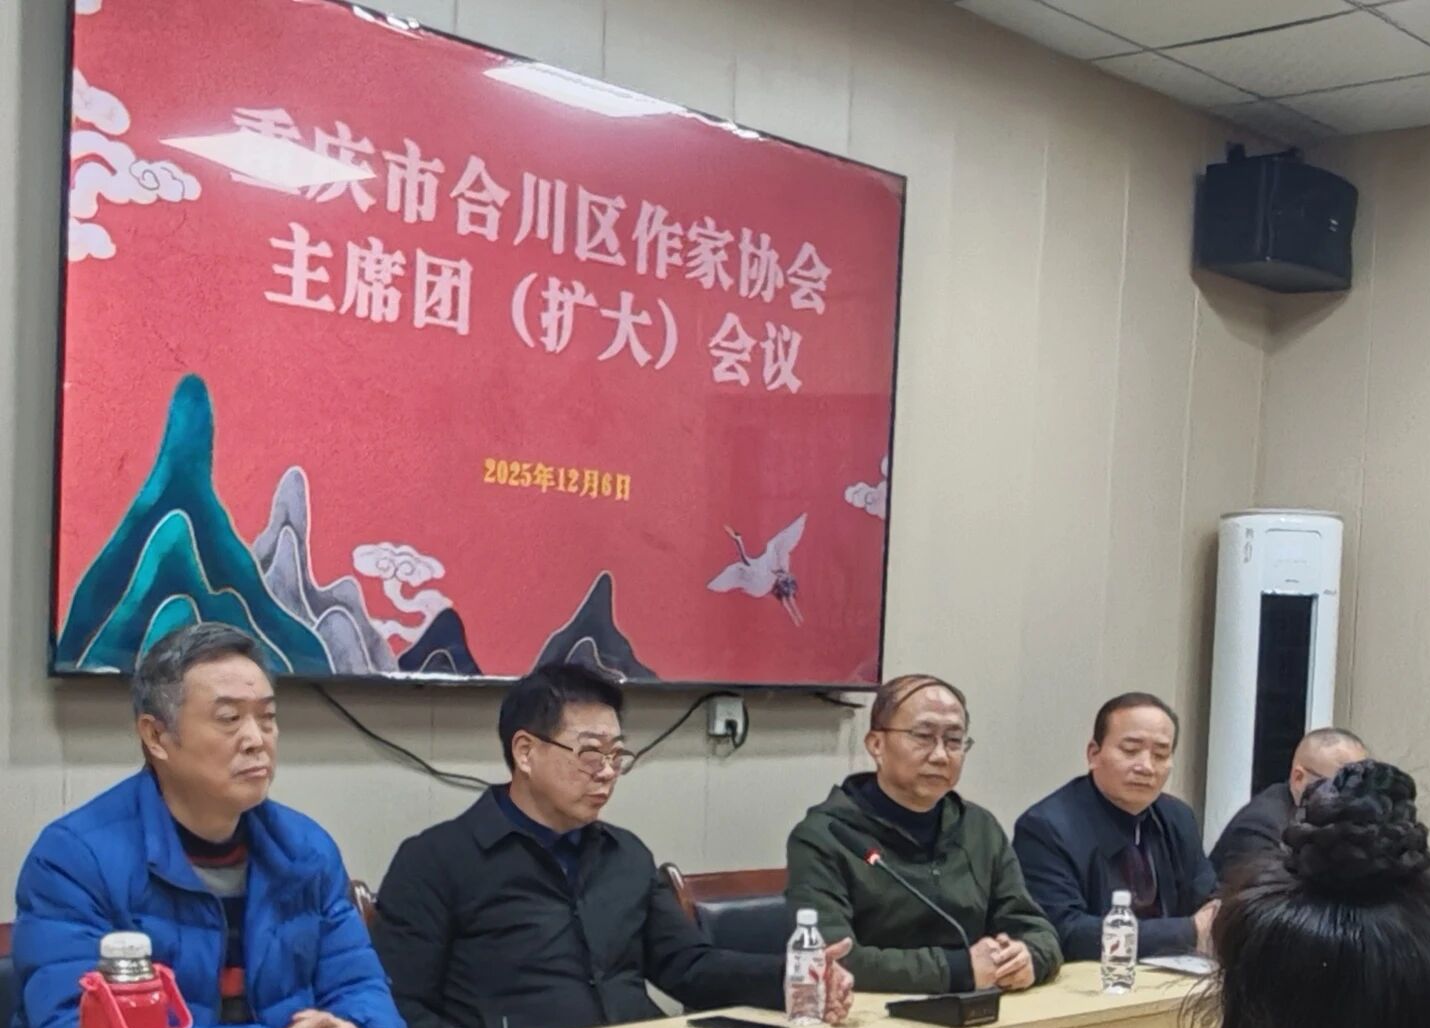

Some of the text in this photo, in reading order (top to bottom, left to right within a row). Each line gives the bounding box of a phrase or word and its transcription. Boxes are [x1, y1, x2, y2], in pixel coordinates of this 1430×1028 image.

[262, 222, 803, 393] 主席团（扩大）会议
[483, 458, 631, 501] 2025年12月6日
